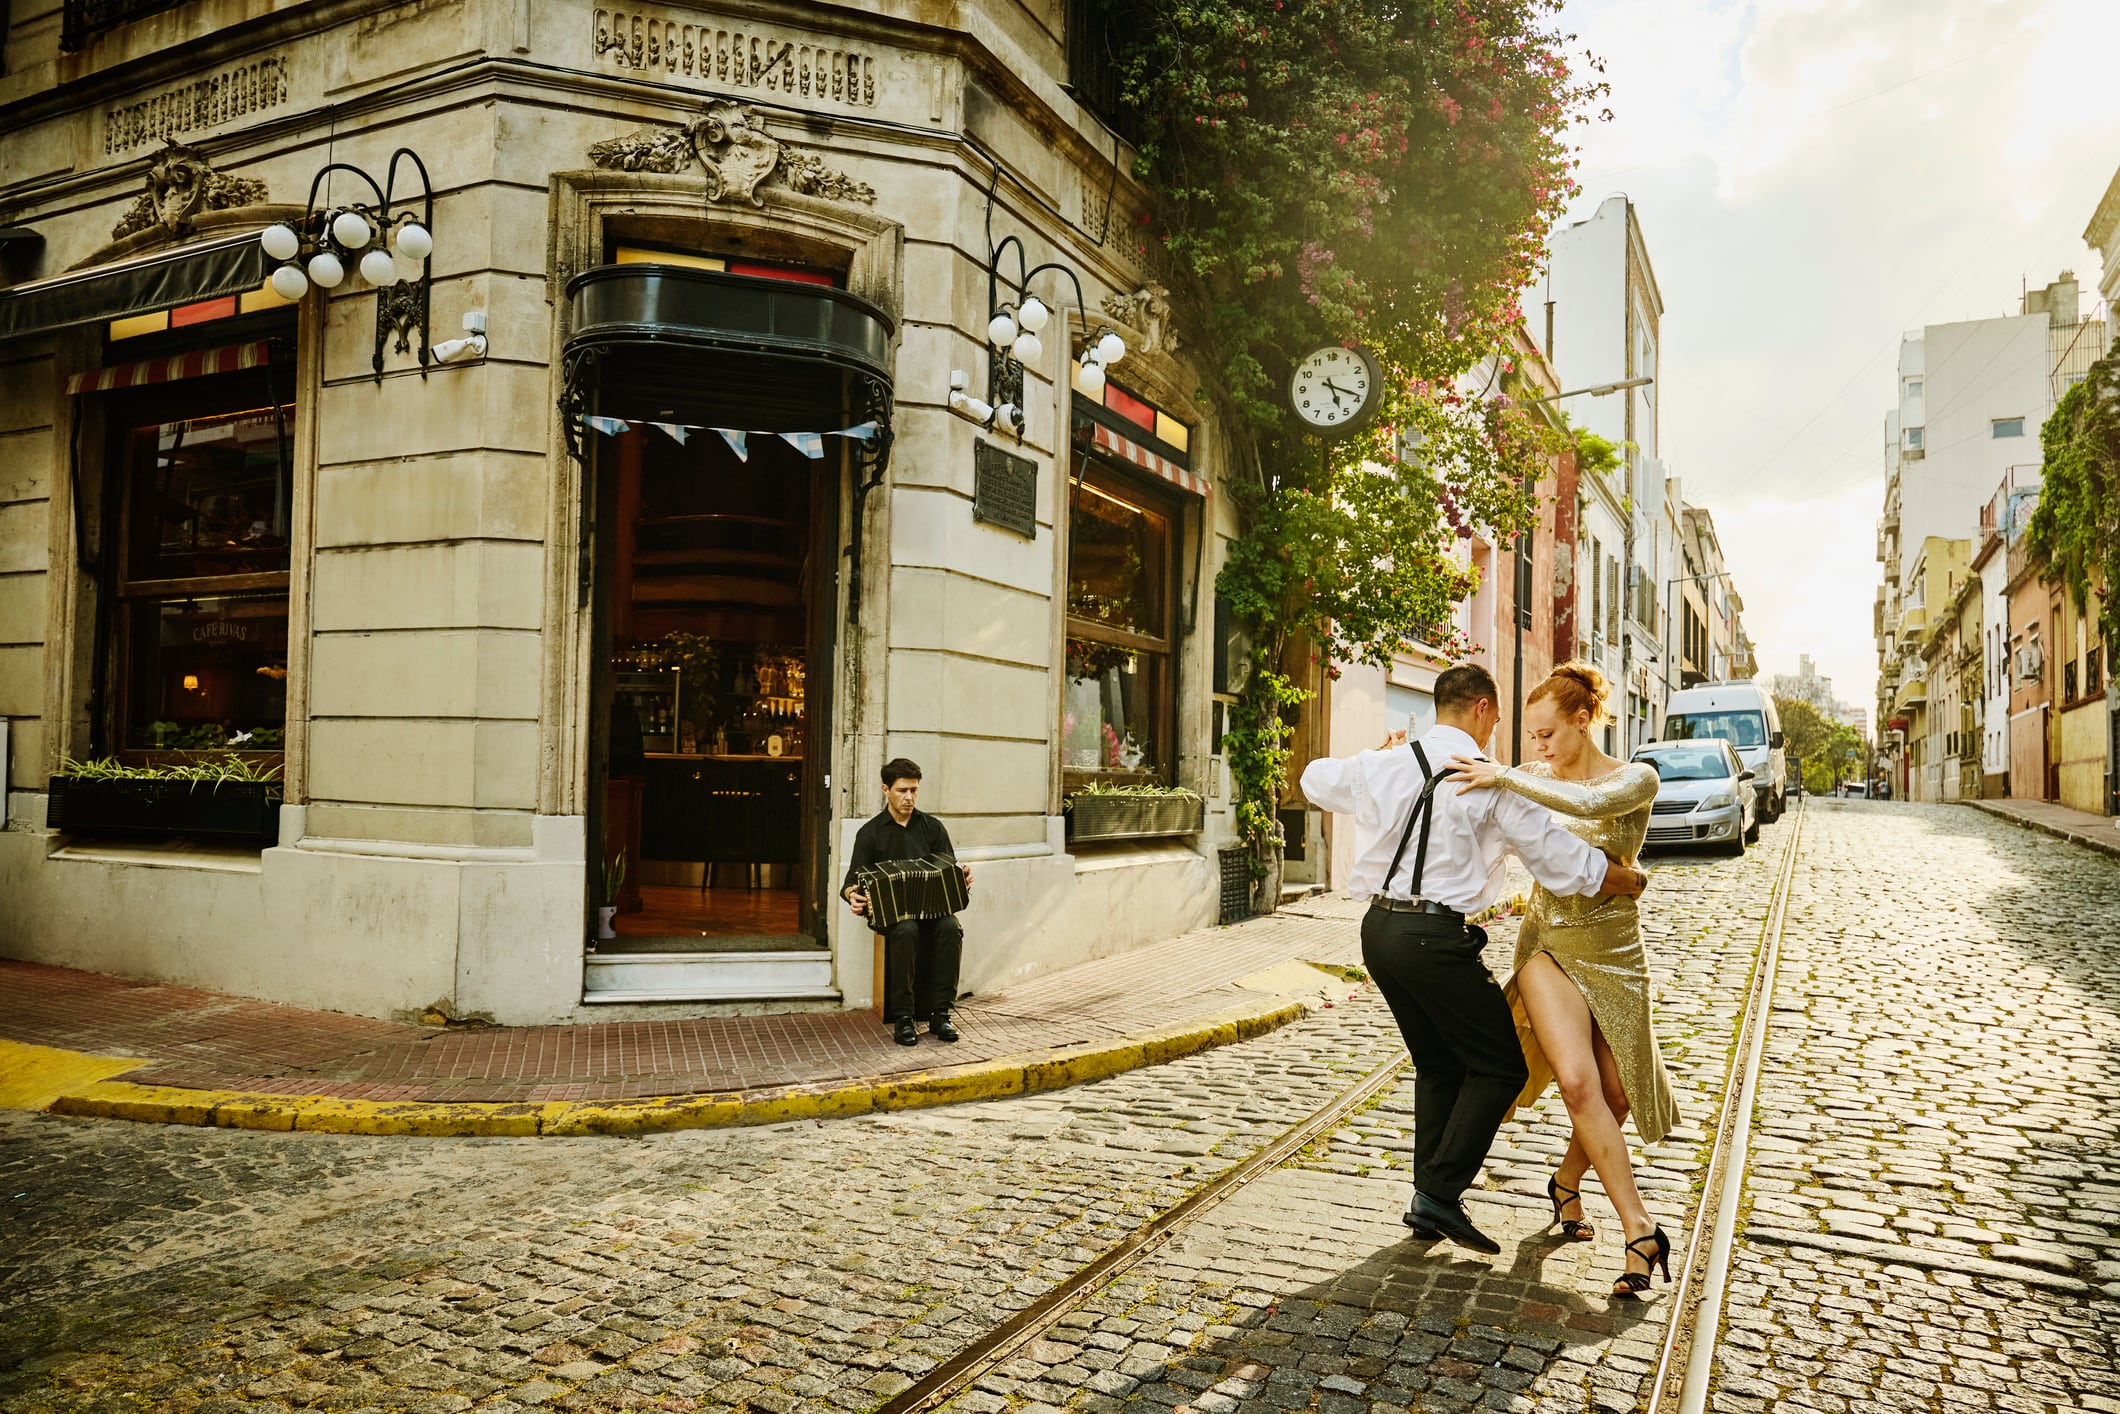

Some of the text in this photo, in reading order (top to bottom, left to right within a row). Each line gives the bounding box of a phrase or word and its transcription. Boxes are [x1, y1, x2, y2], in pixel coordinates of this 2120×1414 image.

[1313, 358, 1321, 366] 11
[1345, 356, 1350, 364] 1
[1354, 366, 1361, 374] 2
[1299, 386, 1306, 394] 9
[1353, 395, 1361, 404] 4
[1303, 400, 1310, 408] 8
[1313, 409, 1320, 418] 7
[1343, 408, 1350, 416] 5
[219, 622, 247, 641] RIVAS
